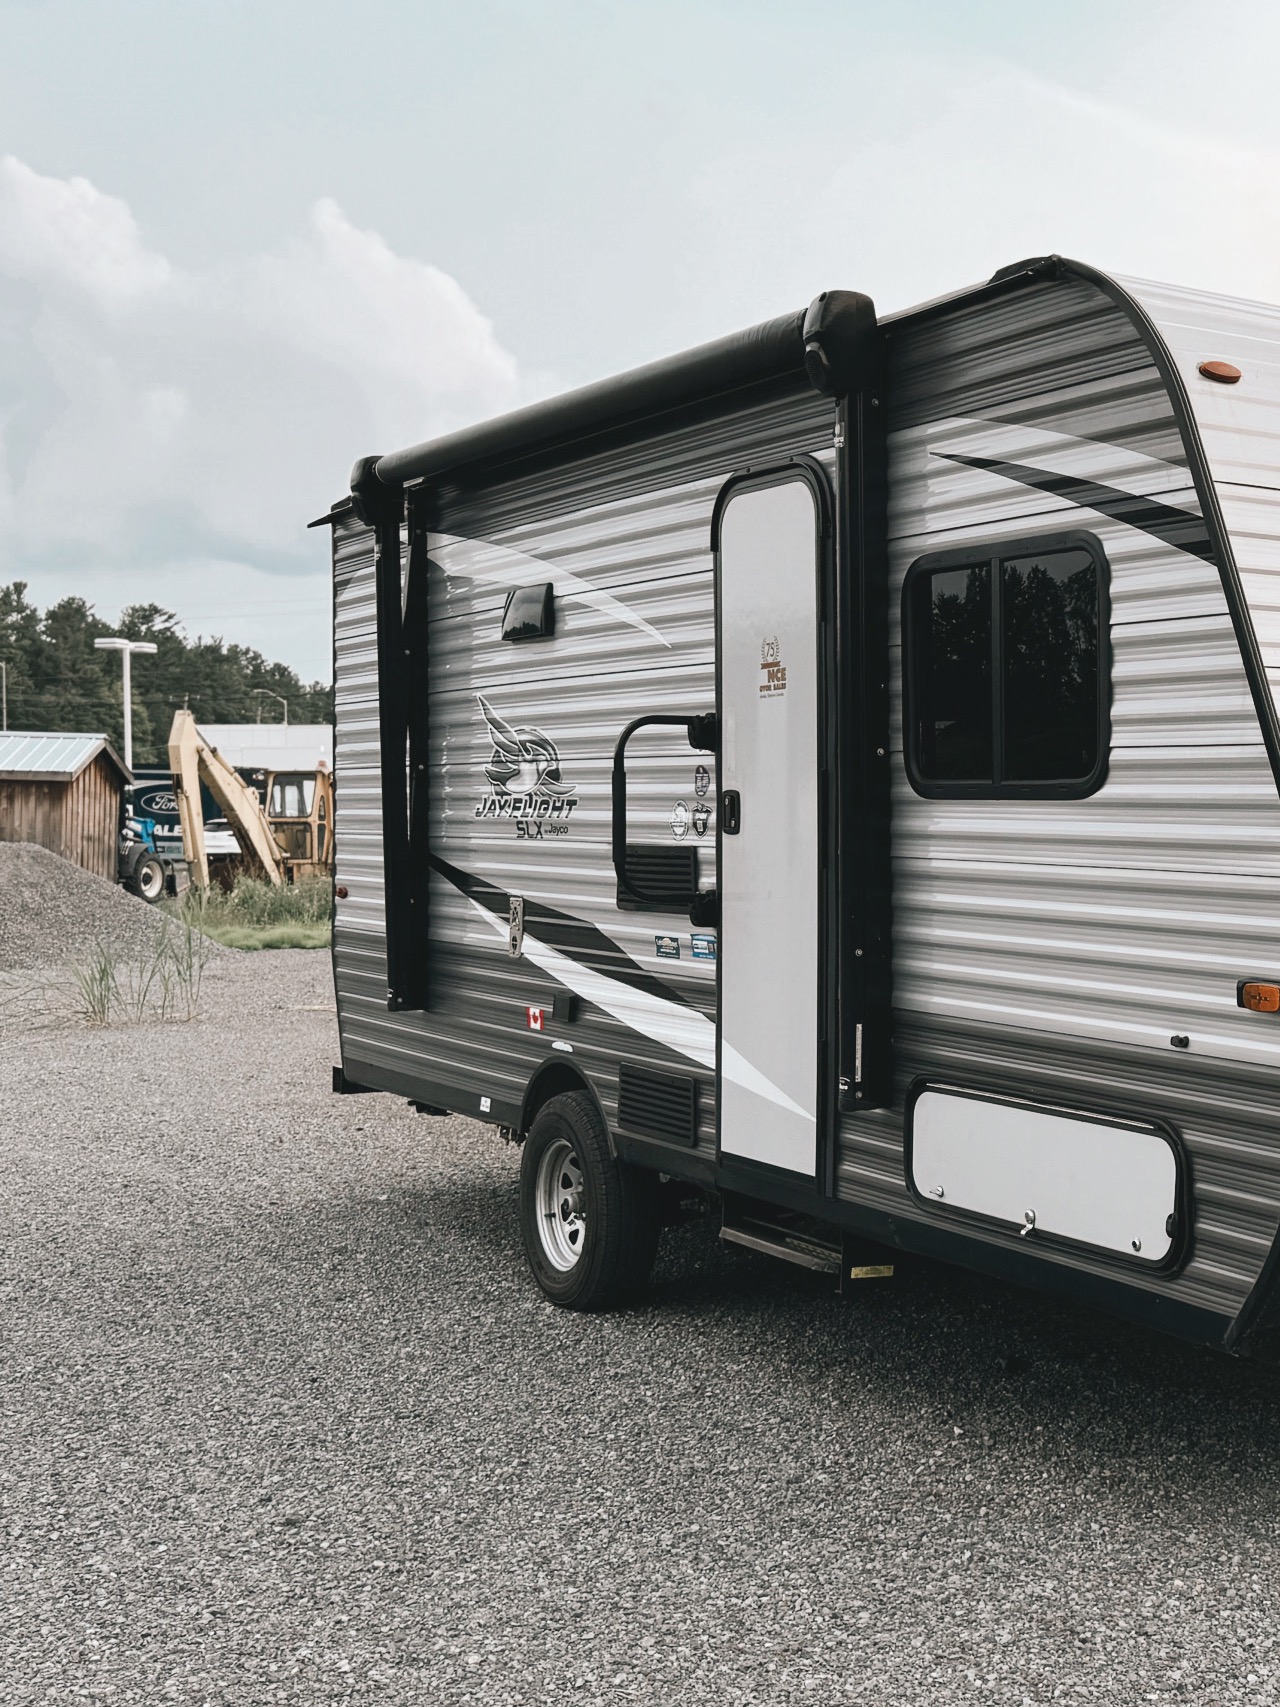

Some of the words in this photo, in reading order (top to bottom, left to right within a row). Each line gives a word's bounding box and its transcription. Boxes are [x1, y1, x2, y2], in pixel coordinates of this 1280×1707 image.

[152, 794, 179, 810] For
[475, 797, 509, 818] JAY
[508, 797, 578, 819] FLIGHT
[516, 820, 544, 839] SLX
[548, 823, 569, 836] Jayco
